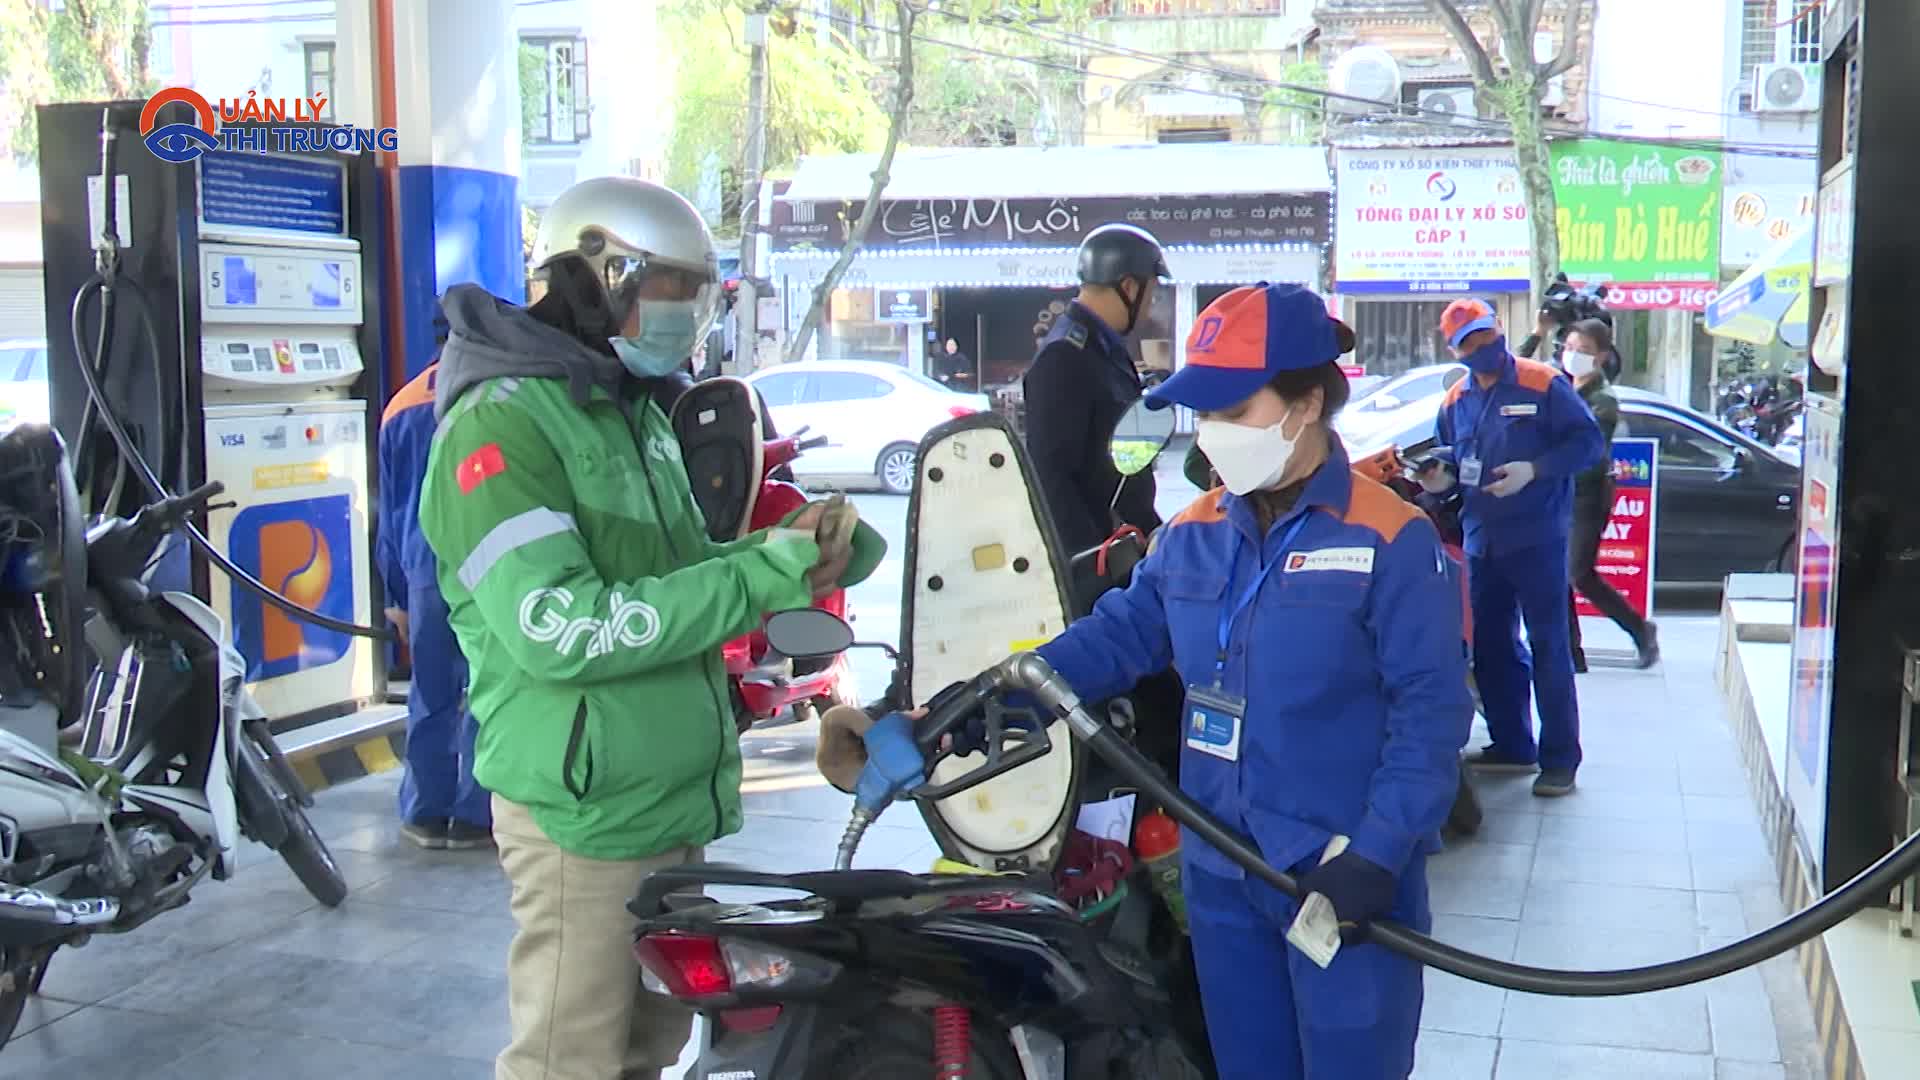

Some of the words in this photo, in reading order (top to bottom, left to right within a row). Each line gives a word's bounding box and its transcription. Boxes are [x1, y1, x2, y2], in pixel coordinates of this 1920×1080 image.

[1384, 160, 1395, 169] TY
[1556, 204, 1605, 262] Bún
[1613, 203, 1648, 262] Bò
[1656, 192, 1716, 262] Huế
[211, 271, 221, 288] 5
[343, 277, 352, 293] 6
[220, 434, 245, 446] VISA
[519, 587, 661, 659] Grab
